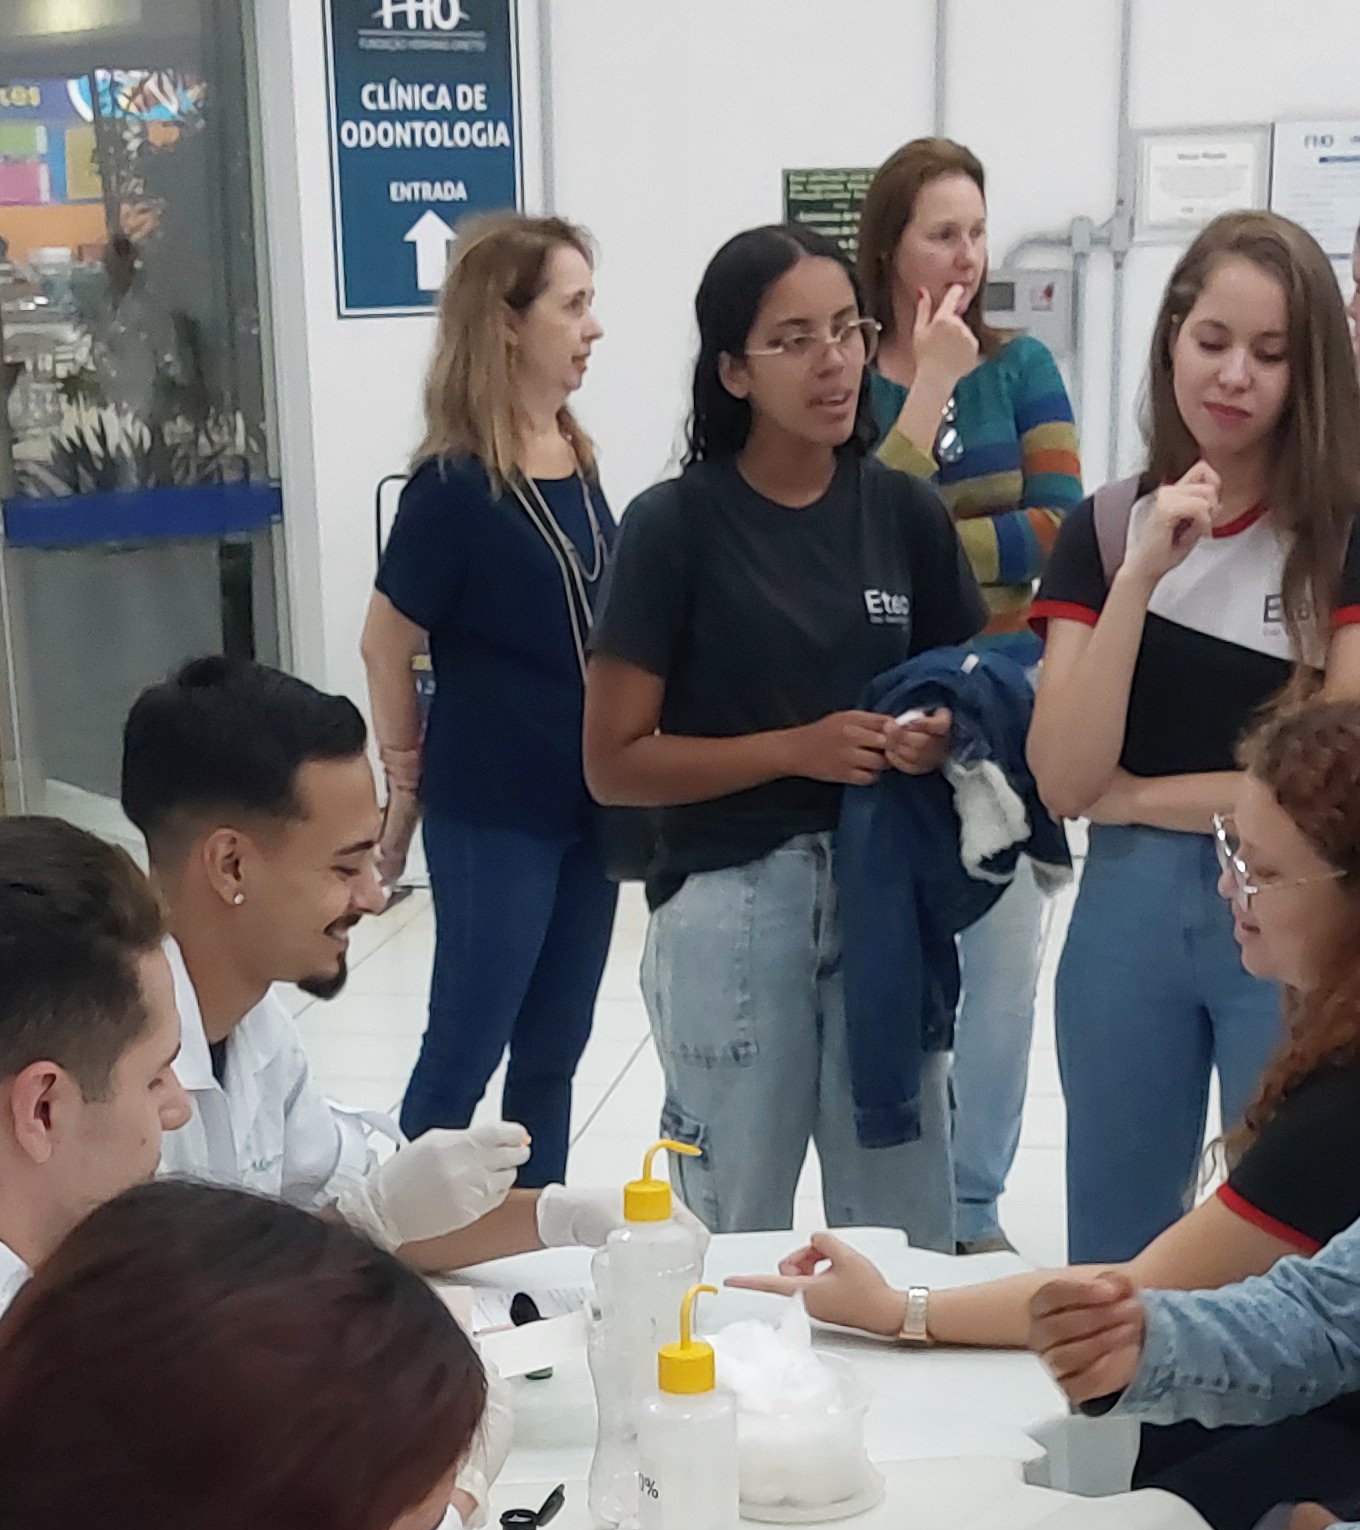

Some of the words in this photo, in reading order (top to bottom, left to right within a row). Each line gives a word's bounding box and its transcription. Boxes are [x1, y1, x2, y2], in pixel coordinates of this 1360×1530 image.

[360, 77, 453, 111] CLÍNICA
[455, 83, 488, 111] DE
[340, 120, 511, 148] ODONTOLOGIA
[389, 180, 468, 202] ENTRADA
